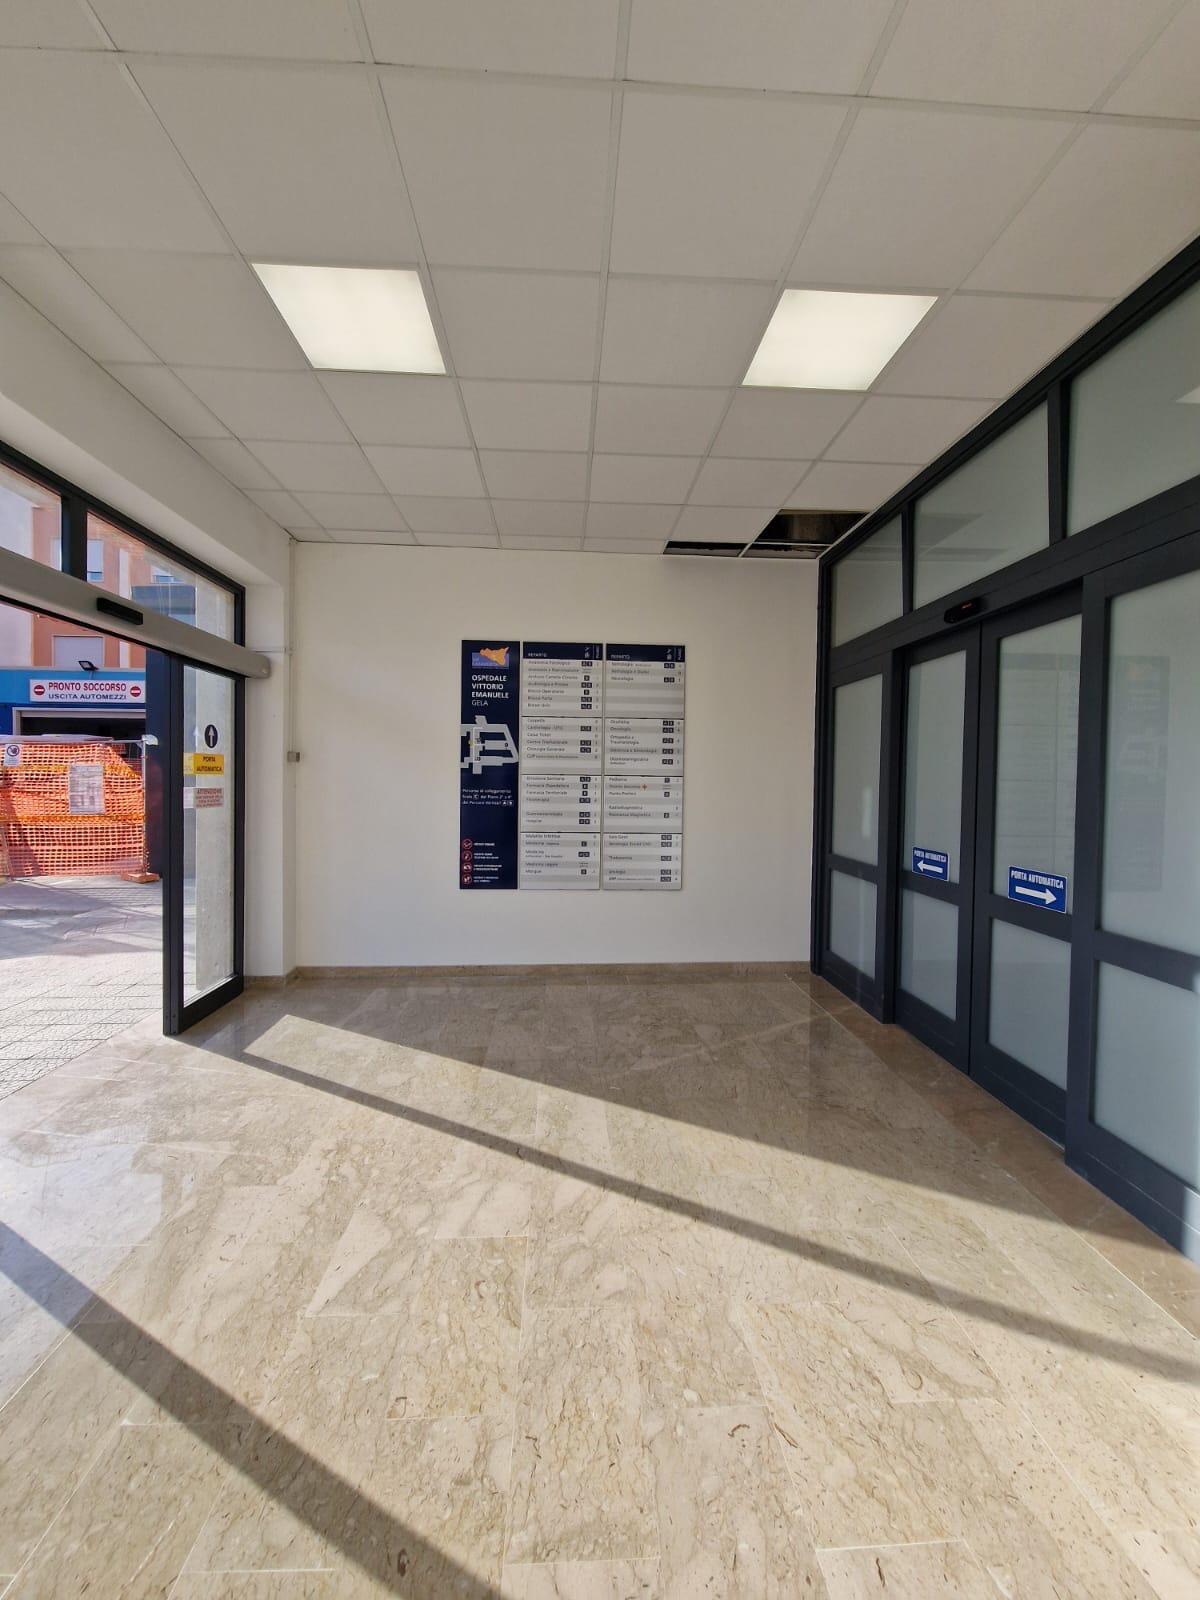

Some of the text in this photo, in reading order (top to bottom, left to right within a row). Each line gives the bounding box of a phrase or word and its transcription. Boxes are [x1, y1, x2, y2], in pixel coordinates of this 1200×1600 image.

[472, 674, 507, 682] OSPEDALE
[49, 682, 127, 692] PRONTO SOCCORSO
[471, 691, 509, 699] EMANUELE
[1011, 870, 1064, 890] PORTA AUTOMATICA
